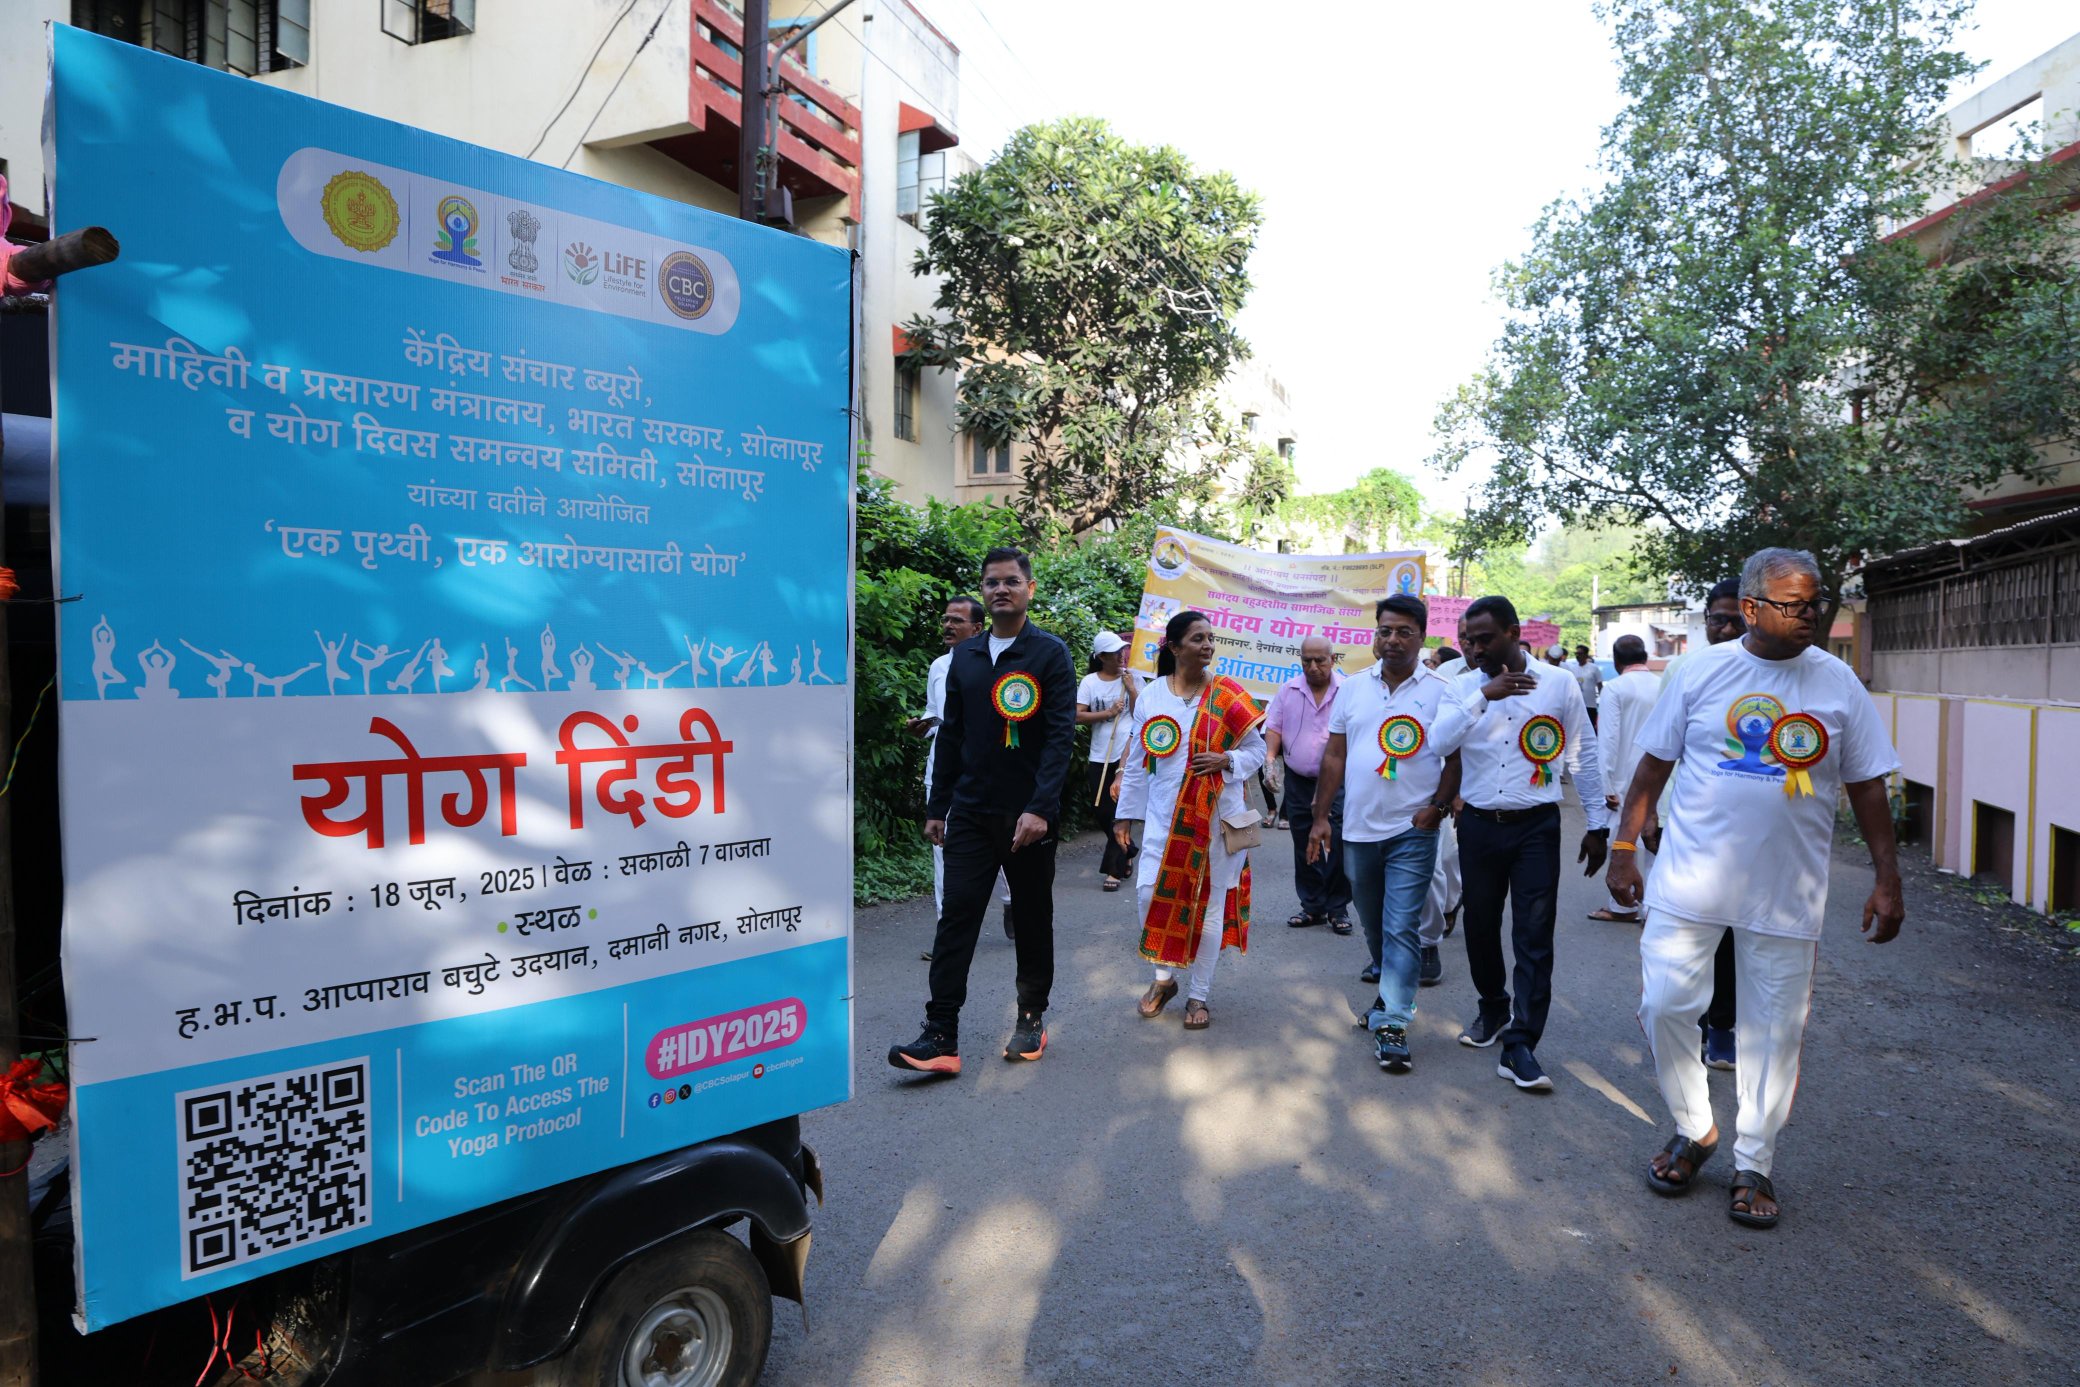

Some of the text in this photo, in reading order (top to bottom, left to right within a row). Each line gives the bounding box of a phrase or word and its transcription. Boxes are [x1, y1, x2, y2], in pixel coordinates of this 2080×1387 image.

[501, 275, 545, 292] भारत सरकार
[603, 275, 643, 290] Lifestyle for
[604, 251, 646, 280] LiFE
[669, 276, 705, 299] CBC
[603, 283, 646, 298] Environment
[502, 349, 575, 391] संचार
[584, 366, 653, 408] ब्यूरो,
[110, 337, 823, 471] माहिती व प्रसारण मंत्रालय, भारत सरकार, सोलापूर
[226, 403, 765, 502] व योग दिवस समन्वय समिती, सोलापूर
[407, 480, 650, 526] यांच्या वतीने आयोजित
[352, 522, 443, 570] पृथ्वी,
[455, 536, 508, 566] एक
[517, 533, 682, 575] आरोग्यासाठी
[1187, 605, 1375, 646] र्वोदय योग मंडळ
[1291, 603, 1335, 615] सामाजिक
[1339, 606, 1363, 617] संस्था
[1256, 640, 1283, 655] देगांव
[292, 707, 734, 850] योग दिंडी
[1735, 771, 1764, 783] Harmony
[233, 886, 332, 925] दिनांक
[347, 895, 354, 912] :
[370, 882, 401, 909] 18
[408, 877, 467, 911] जून,
[480, 867, 535, 895] 2025
[554, 856, 592, 885] वेळ
[603, 864, 609, 879] :
[619, 840, 691, 877] सकाळी
[699, 845, 709, 865] 7
[715, 838, 771, 862] वाजता
[515, 905, 582, 937] स्थळ
[175, 905, 802, 1039] ह.भ.प. आप्पाराव बचुटे उदयान, दमानी नगर, सोलापूर
[657, 1005, 798, 1072] #IDY2025
[453, 1052, 577, 1099] Scan The QR
[694, 1070, 750, 1094] @CBCSolapur
[415, 1076, 609, 1138] Code To Access The
[448, 1107, 582, 1159] Yoga Protocol
